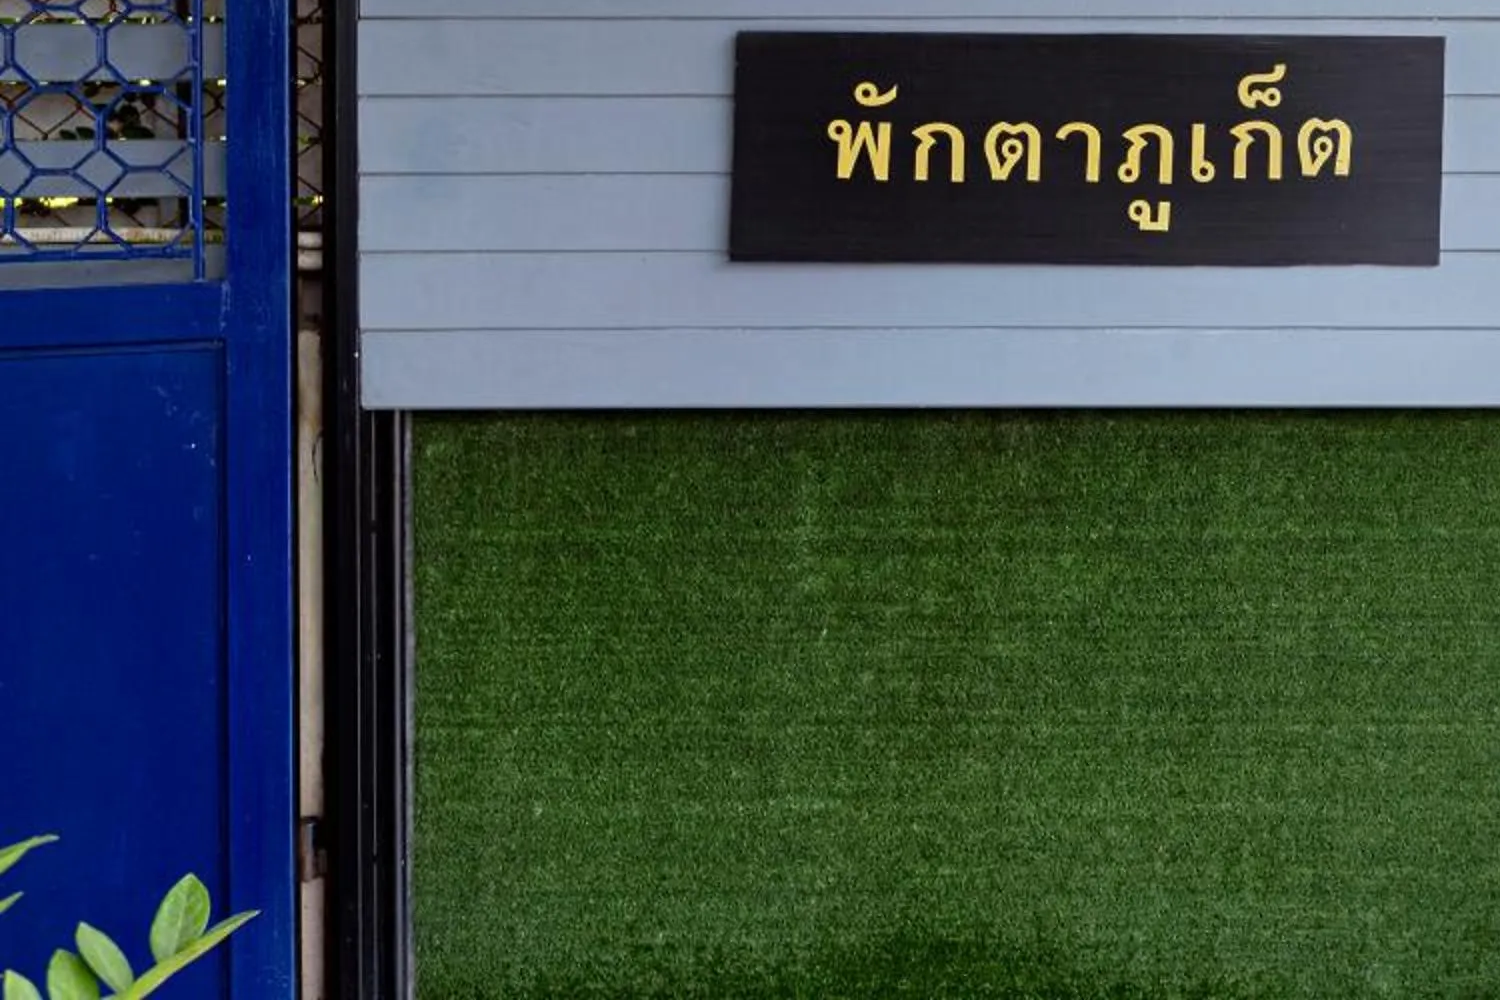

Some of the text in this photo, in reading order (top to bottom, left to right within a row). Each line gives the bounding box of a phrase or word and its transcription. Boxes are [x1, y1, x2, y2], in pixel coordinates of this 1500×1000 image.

[827, 63, 1353, 231] พักตาภูเก็ต
